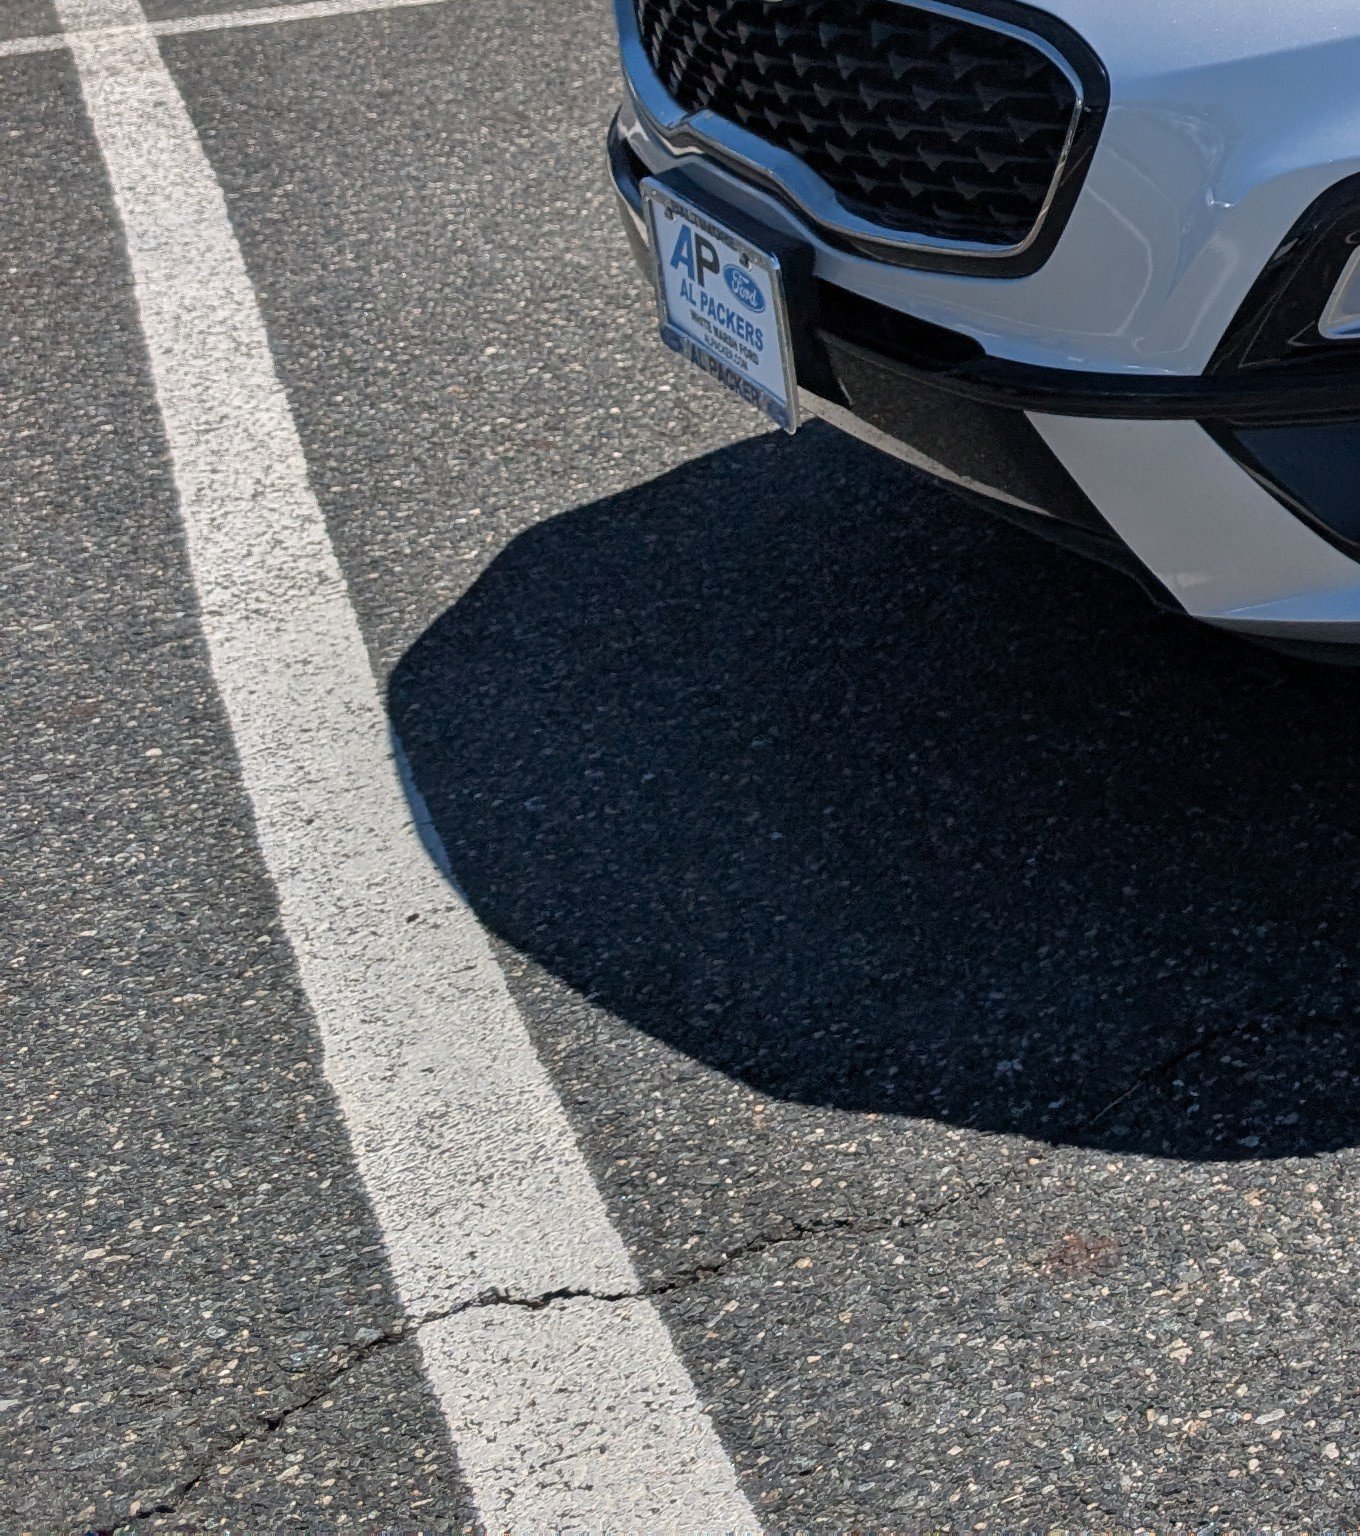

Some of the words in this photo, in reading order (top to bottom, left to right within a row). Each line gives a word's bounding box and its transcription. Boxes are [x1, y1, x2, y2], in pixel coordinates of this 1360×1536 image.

[670, 224, 720, 288] AP
[680, 278, 697, 306] AL
[701, 290, 764, 352] PACKERS
